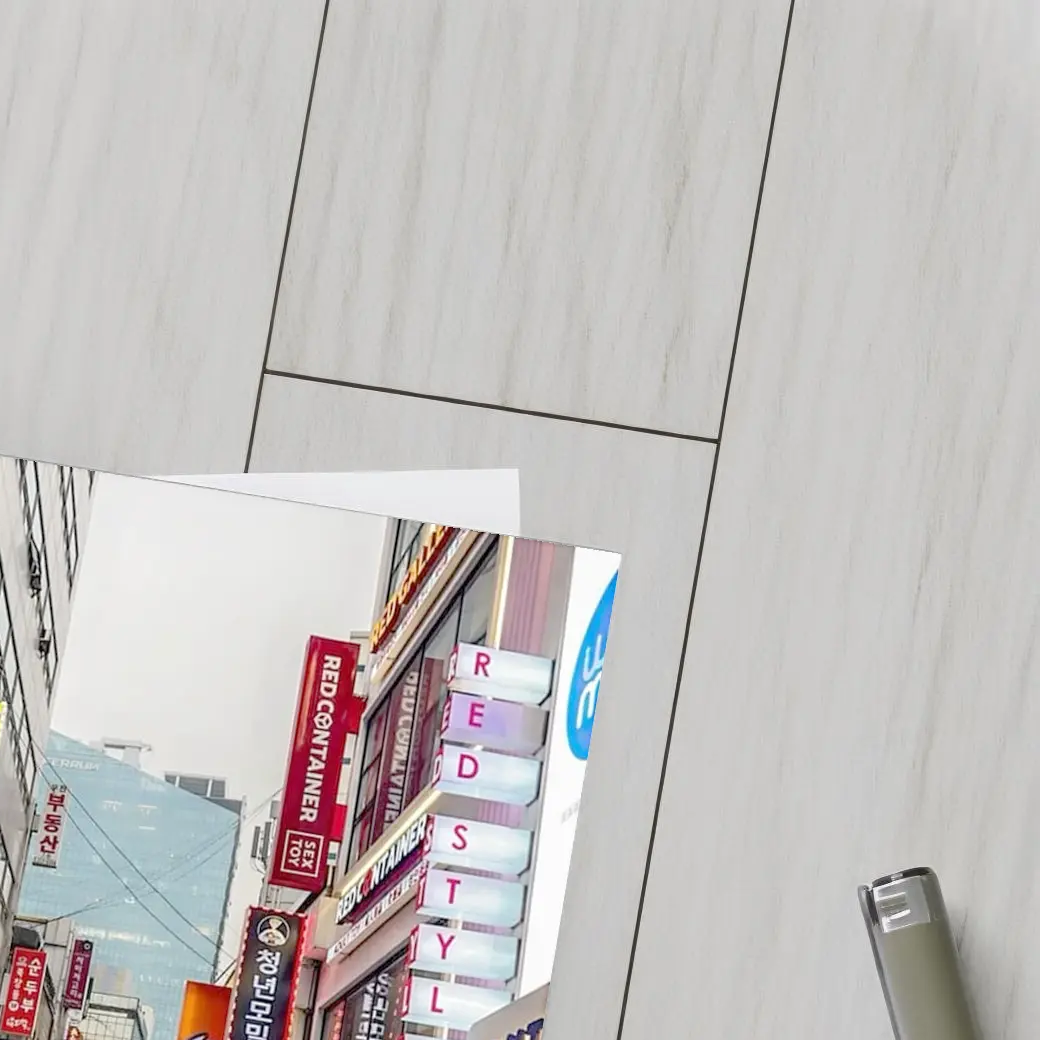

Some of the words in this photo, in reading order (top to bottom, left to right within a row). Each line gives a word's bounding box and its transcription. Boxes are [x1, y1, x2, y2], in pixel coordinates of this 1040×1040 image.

[370, 597, 399, 652] RED
[39, 793, 65, 854] 부동산
[288, 838, 302, 868] TOY
[301, 841, 317, 869] SEX
[20, 957, 43, 1012] 순두부
